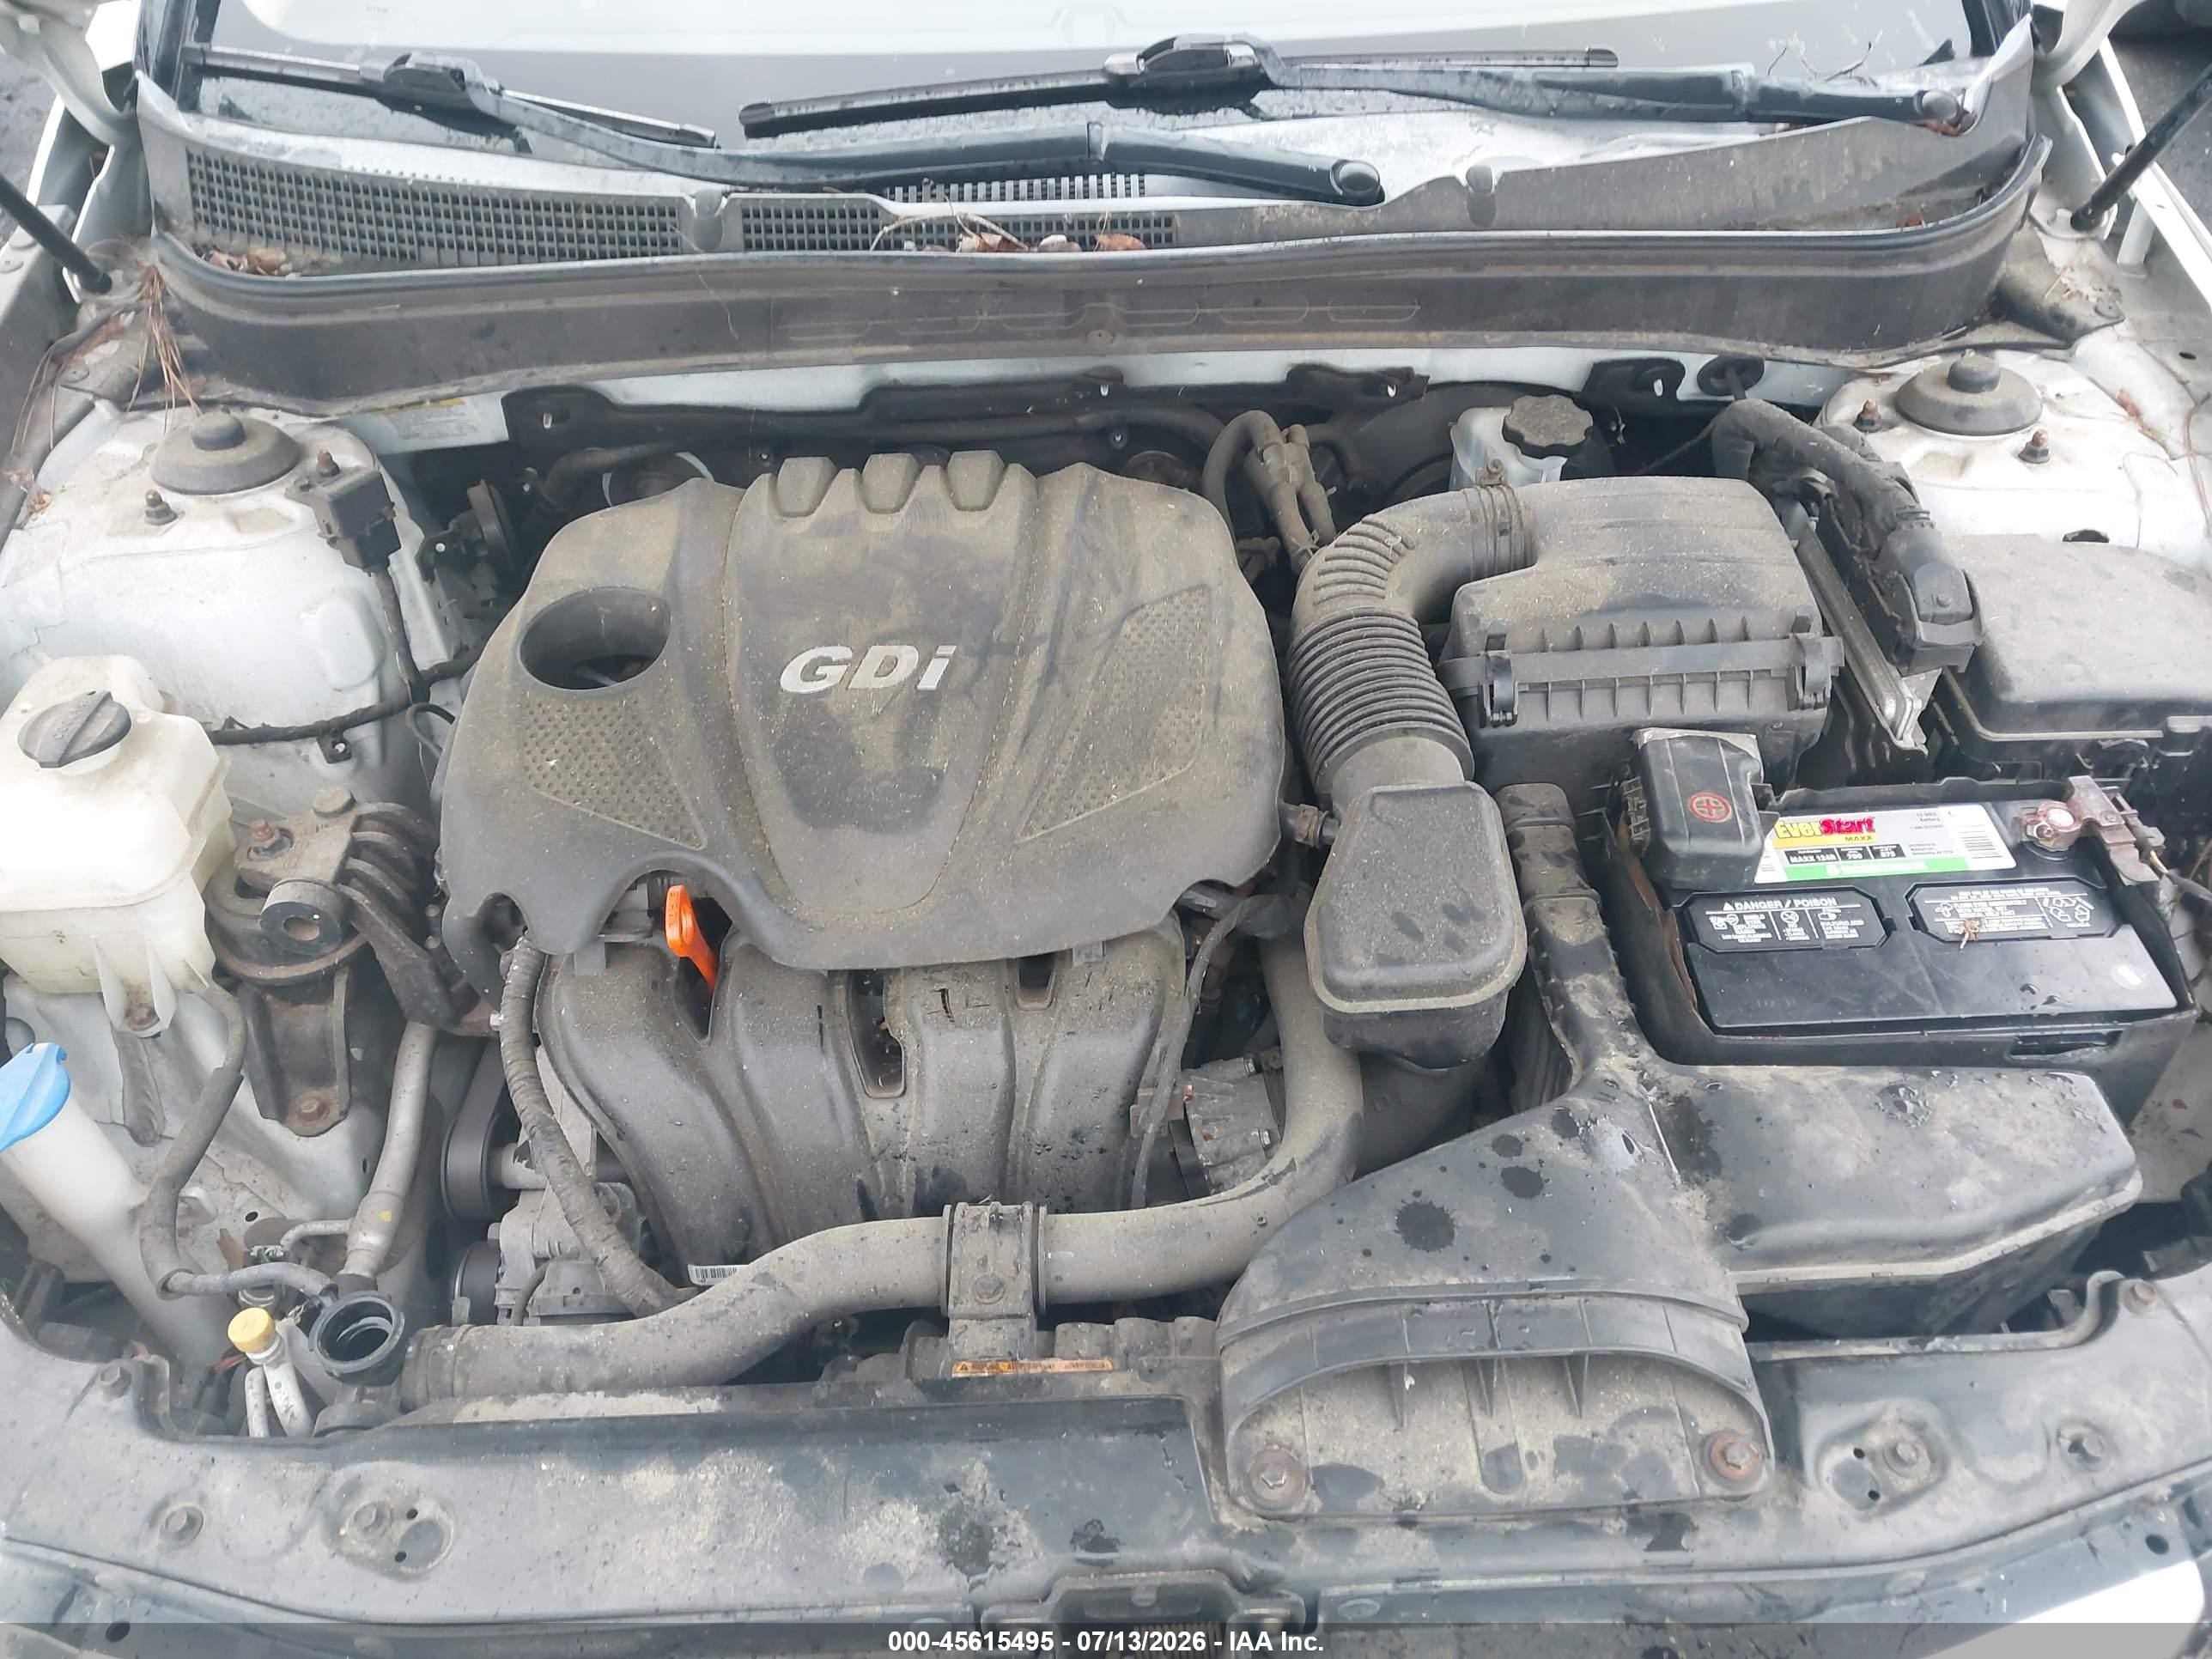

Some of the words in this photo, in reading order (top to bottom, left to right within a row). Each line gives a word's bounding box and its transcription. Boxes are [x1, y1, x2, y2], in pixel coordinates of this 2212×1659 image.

[780, 645, 957, 694] GDi
[1774, 816, 1875, 839] EverStart
[1844, 834, 1873, 842] MAXX
[1734, 899, 1784, 910] DANGER
[1793, 896, 1838, 908] POISON
